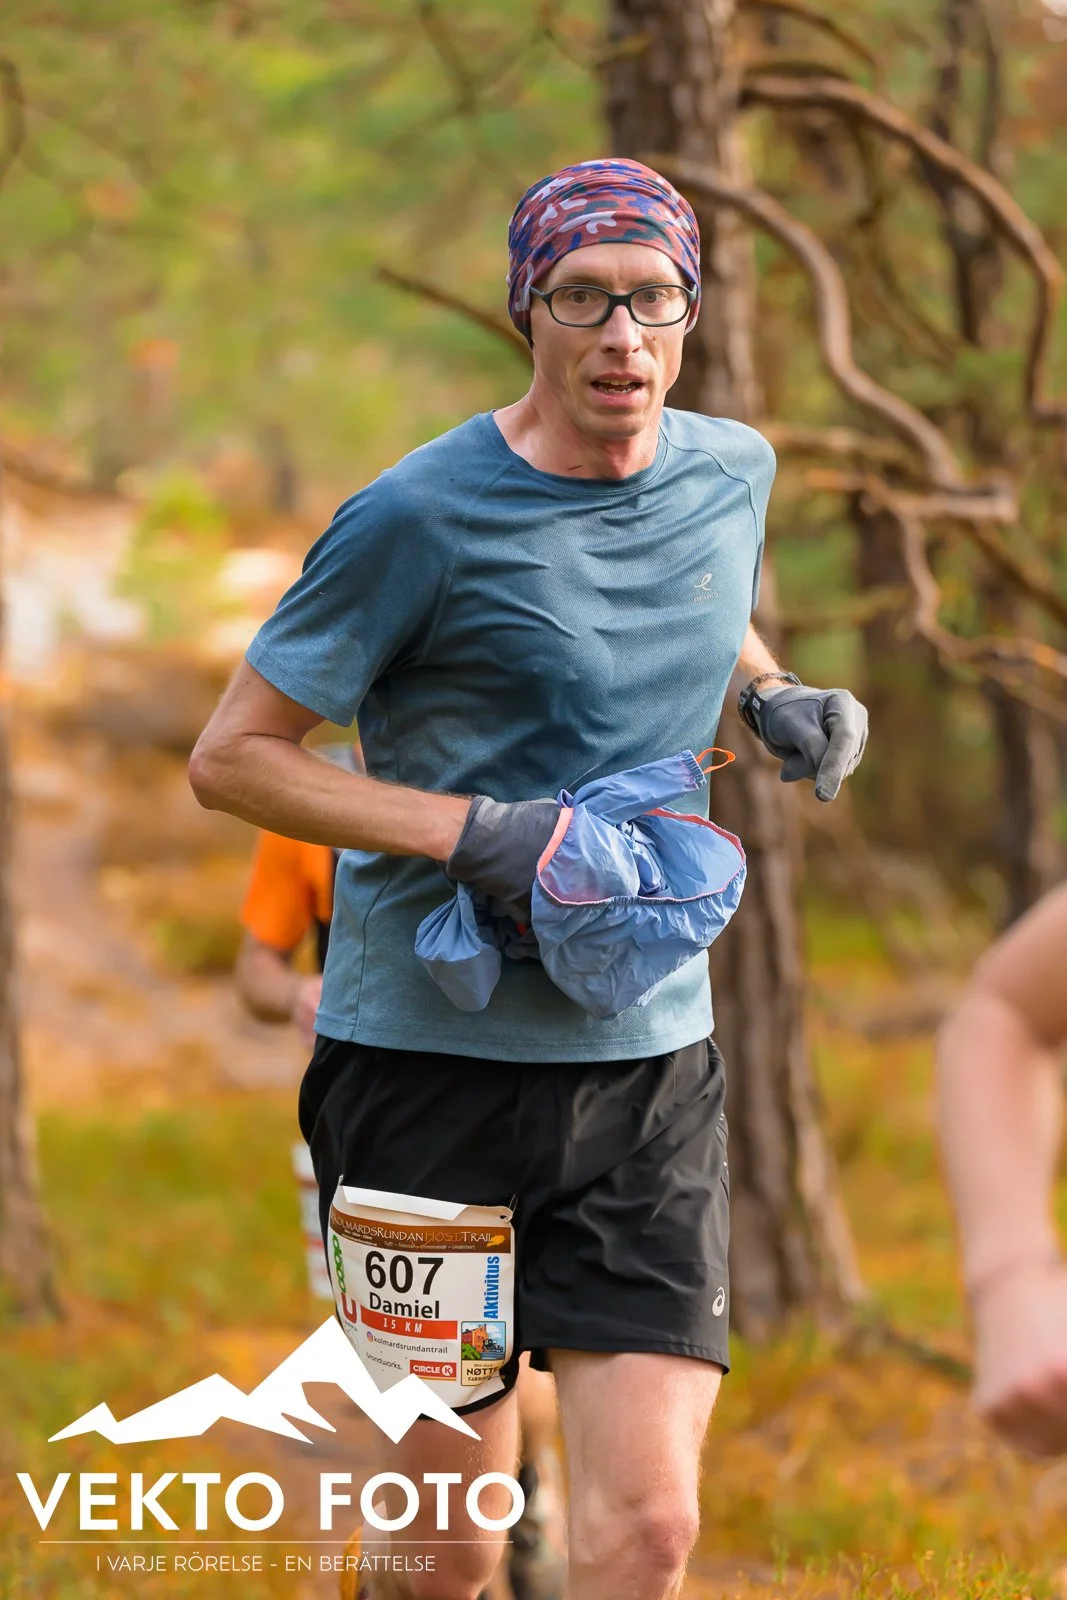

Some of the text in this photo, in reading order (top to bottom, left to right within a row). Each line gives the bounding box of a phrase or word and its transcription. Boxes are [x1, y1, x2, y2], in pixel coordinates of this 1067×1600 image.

[365, 1251, 444, 1295] 607
[483, 1256, 500, 1319] Aktivitus
[369, 1292, 440, 1319] Damiel
[383, 1317, 423, 1333] 15 KM
[412, 1364, 441, 1374] CIRCLE
